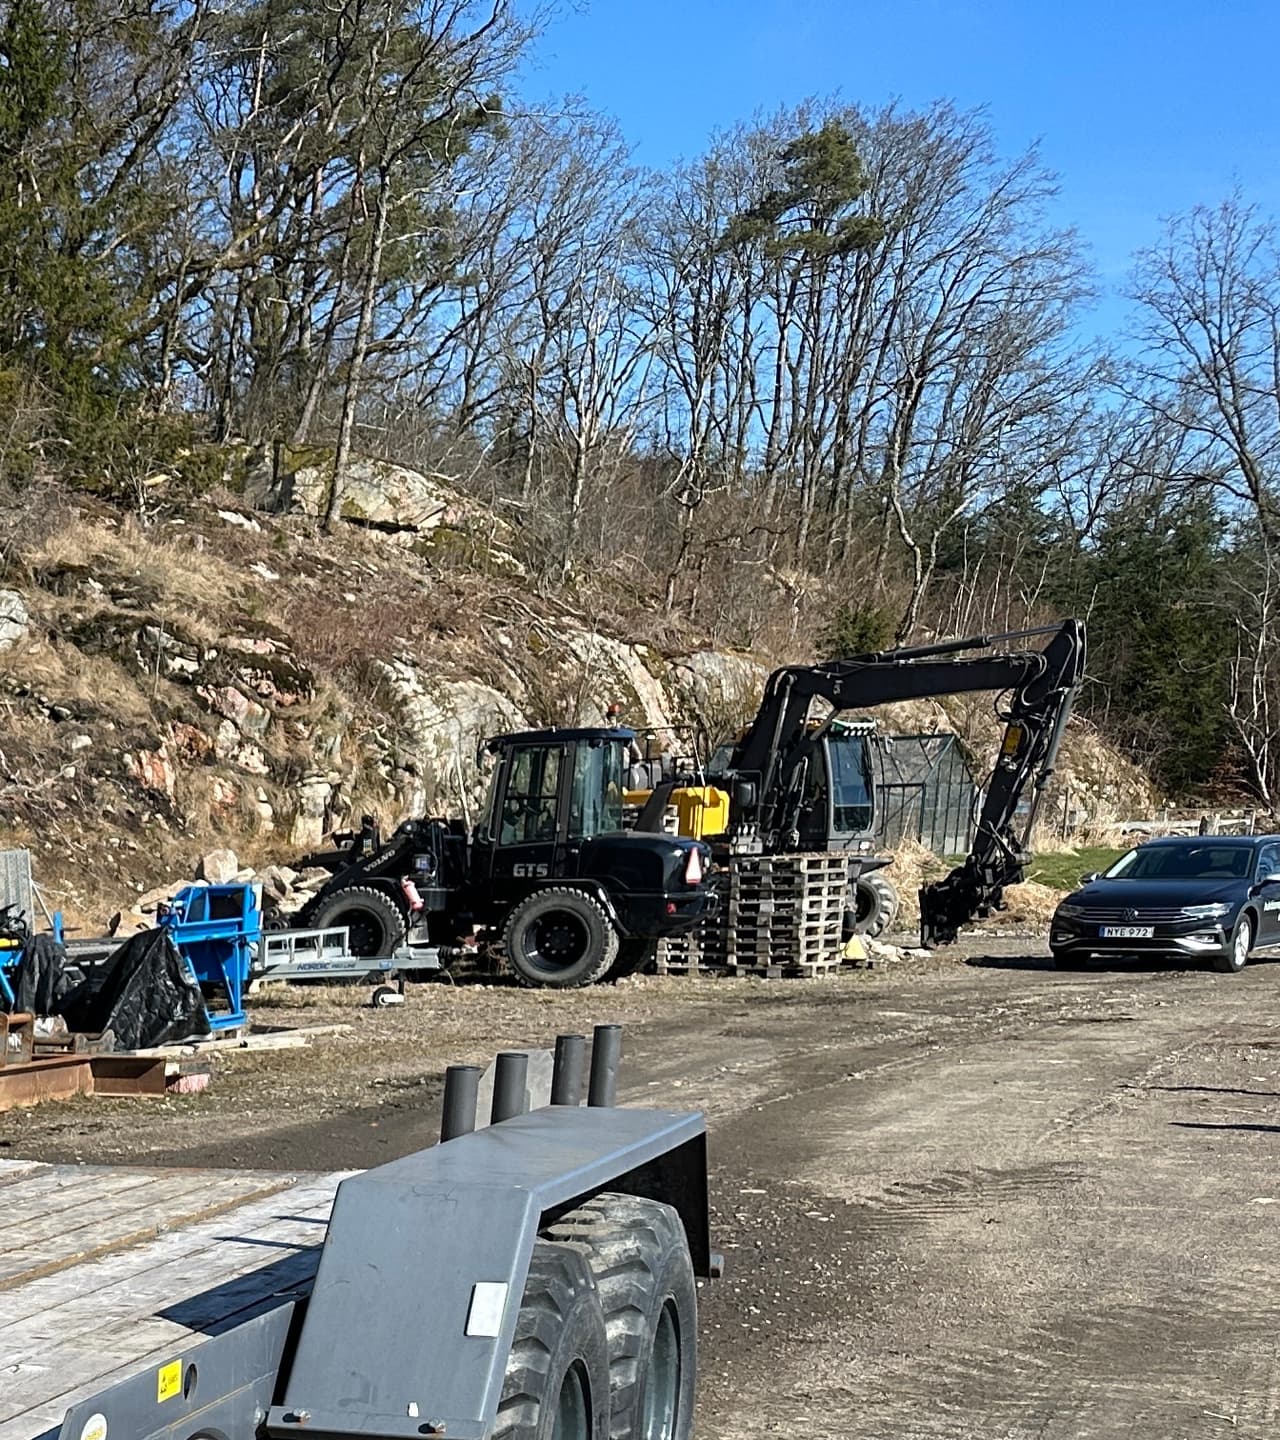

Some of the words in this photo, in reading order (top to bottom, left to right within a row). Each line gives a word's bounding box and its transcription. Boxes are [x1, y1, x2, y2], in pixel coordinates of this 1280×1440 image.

[362, 849, 396, 872] VOLVO
[513, 863, 549, 878] GTS
[1107, 927, 1127, 937] NYE
[1128, 927, 1148, 937] 972
[297, 962, 331, 971] NORDIC
